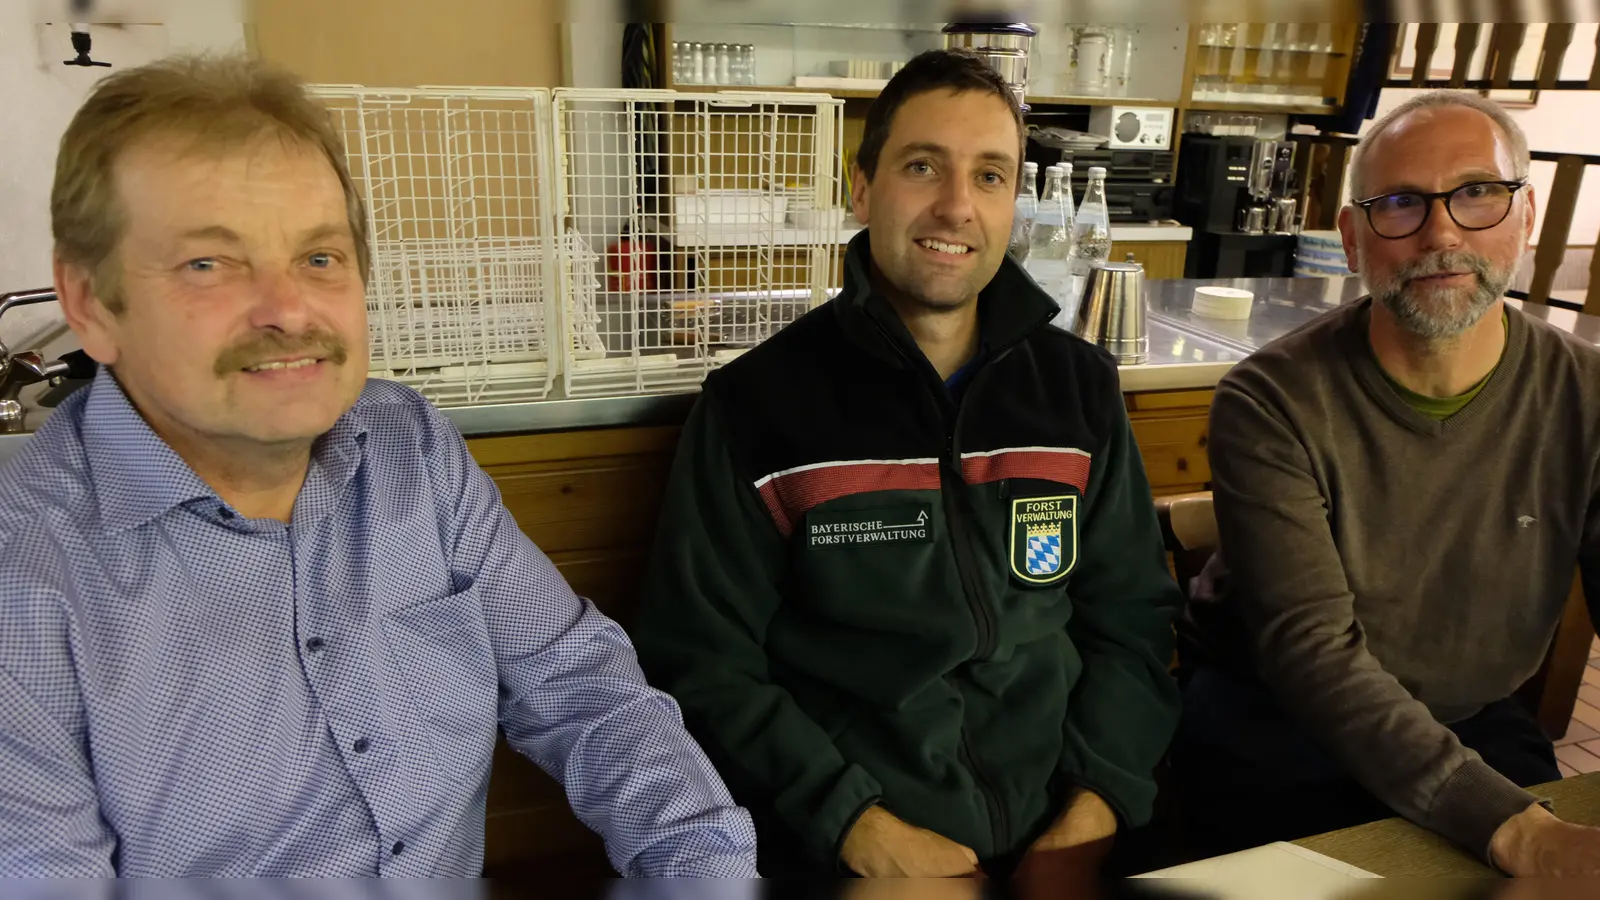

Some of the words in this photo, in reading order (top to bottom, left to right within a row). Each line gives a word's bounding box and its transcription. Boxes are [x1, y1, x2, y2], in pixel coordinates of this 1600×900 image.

[1026, 501, 1062, 512] FORST
[1016, 510, 1073, 523] VERWALTUNG
[811, 521, 883, 534] BAYERISCHE
[811, 529, 926, 545] FORSTVERWALTUNG
